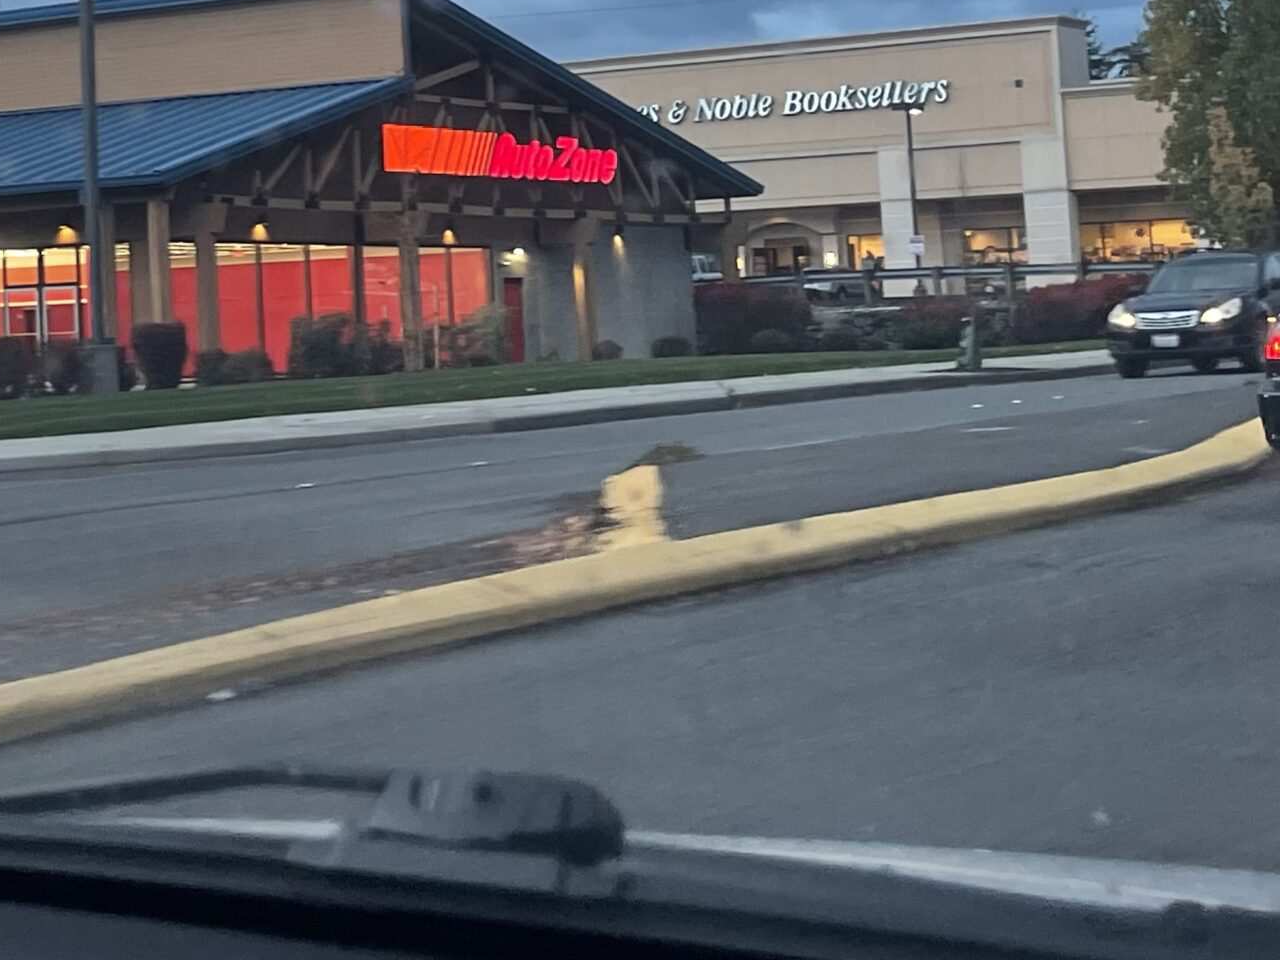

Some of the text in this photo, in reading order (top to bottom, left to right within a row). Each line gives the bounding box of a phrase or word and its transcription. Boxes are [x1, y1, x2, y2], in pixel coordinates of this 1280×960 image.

[668, 100, 688, 124] &
[693, 93, 773, 123] Noble
[783, 79, 949, 116] Booksellers
[489, 132, 618, 184] AutoZone
